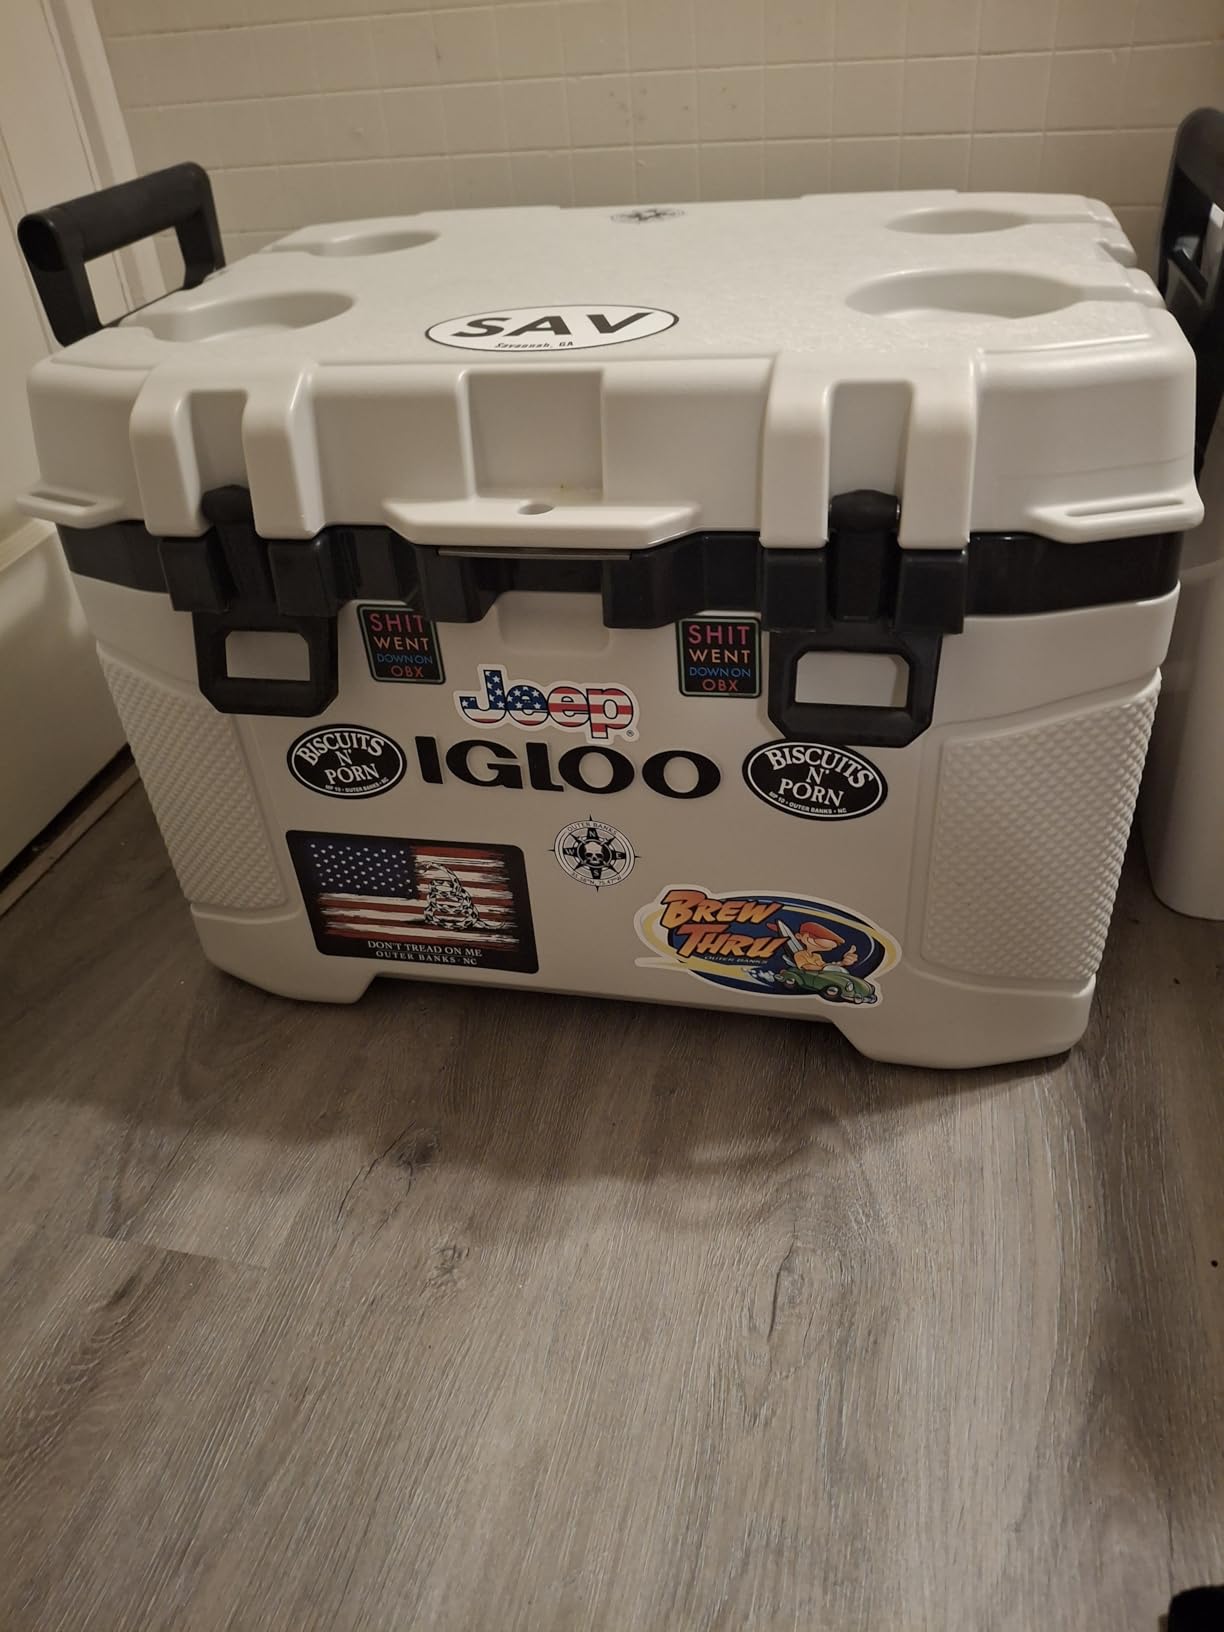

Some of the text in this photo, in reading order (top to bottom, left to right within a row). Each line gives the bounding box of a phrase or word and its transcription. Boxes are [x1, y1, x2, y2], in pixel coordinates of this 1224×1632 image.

[450, 311, 655, 338] SAV
[369, 613, 424, 633] SHIT
[373, 636, 429, 651] WENT
[688, 624, 750, 645] SHIT
[688, 649, 751, 664] WENT
[390, 665, 425, 678] OBX
[702, 679, 738, 692] OBX
[458, 669, 634, 739] Jeep
[296, 732, 385, 766] BISCUITS
[324, 763, 381, 785] PORN
[414, 735, 722, 800] IGLOO
[764, 746, 875, 789] BISCUITS
[777, 778, 845, 807] PORN
[788, 801, 810, 812] OUTER
[660, 889, 784, 929] BREW
[367, 939, 482, 958] DON'T TREAD ON ME
[676, 922, 789, 958] THRU
[376, 950, 478, 966] OUTER BANKS NC
